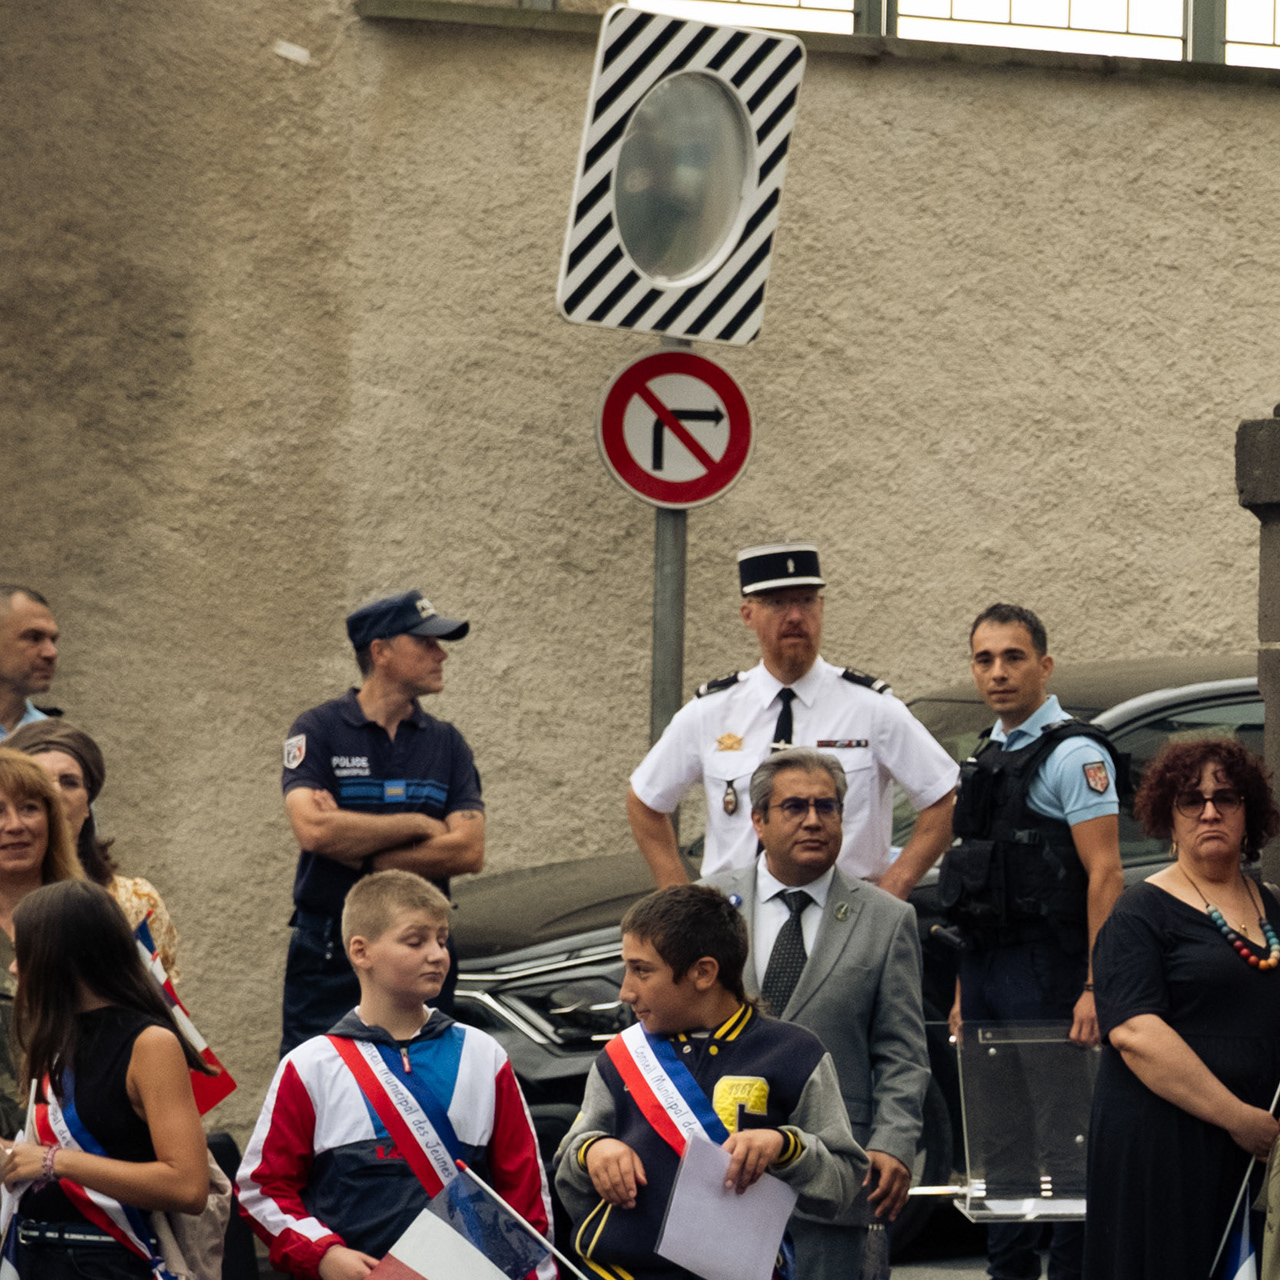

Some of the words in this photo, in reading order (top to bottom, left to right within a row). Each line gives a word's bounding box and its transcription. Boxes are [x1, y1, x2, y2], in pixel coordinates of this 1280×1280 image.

[361, 1042, 382, 1067] onseil
[413, 1118, 430, 1138] des
[634, 1045, 657, 1075] Conseil
[651, 1074, 689, 1120] Municipal
